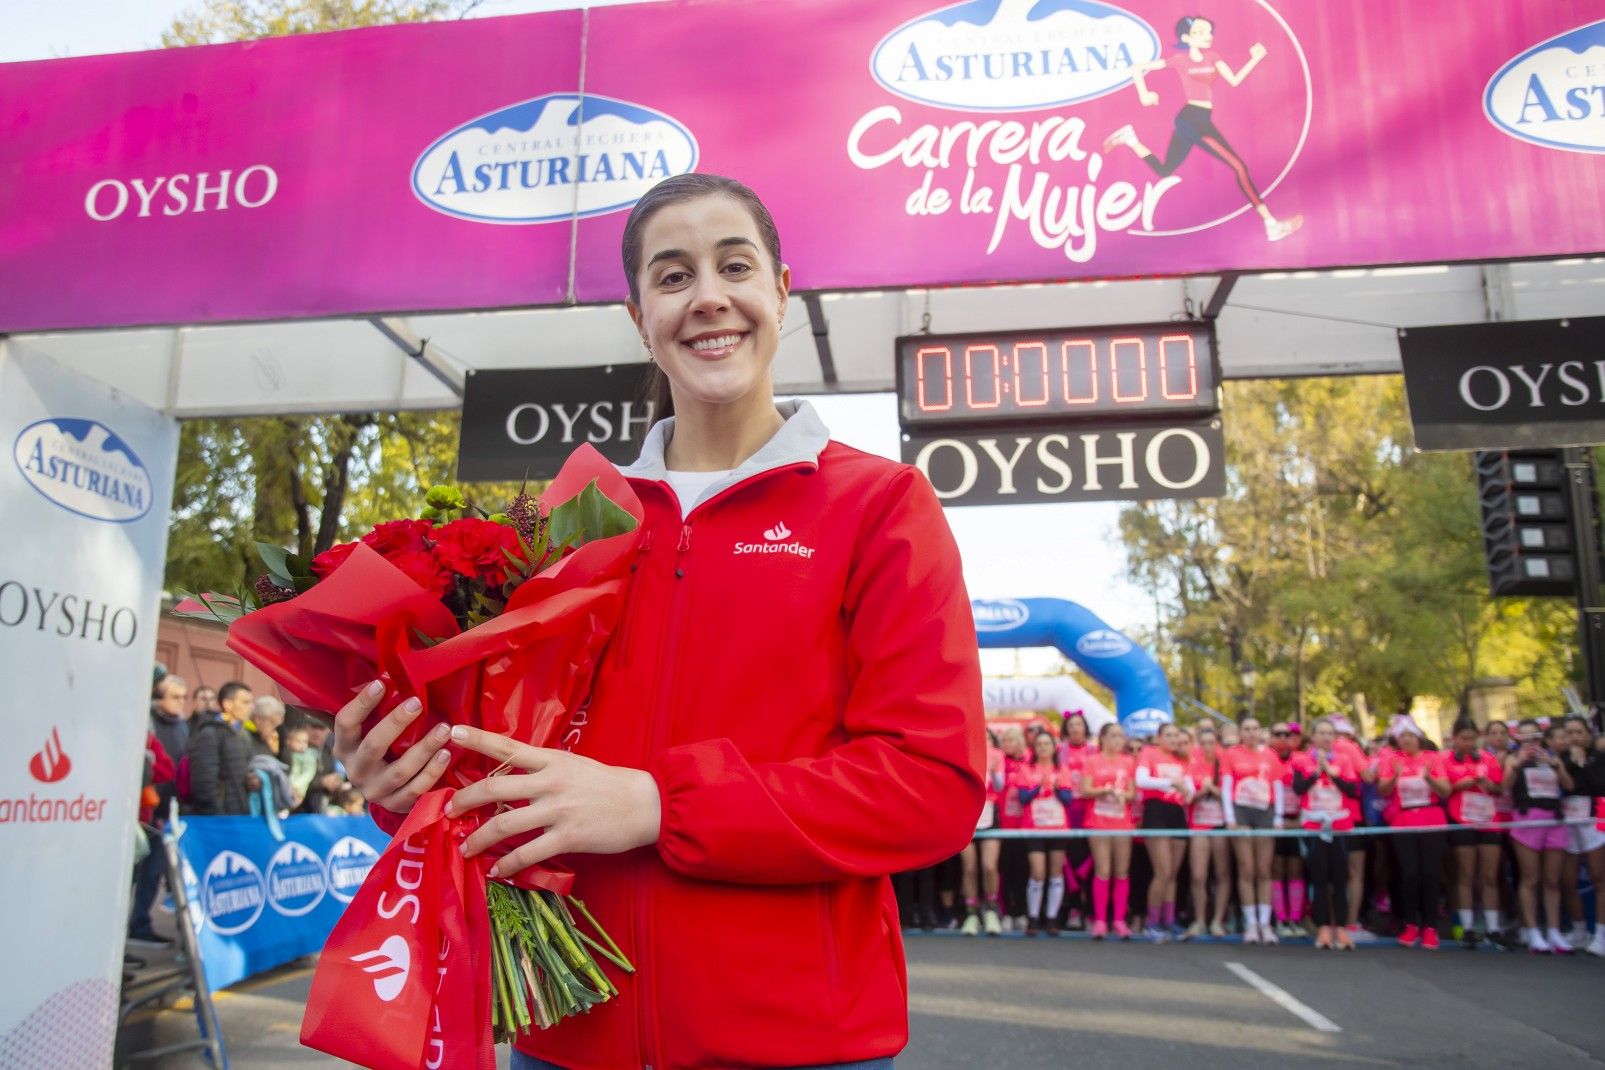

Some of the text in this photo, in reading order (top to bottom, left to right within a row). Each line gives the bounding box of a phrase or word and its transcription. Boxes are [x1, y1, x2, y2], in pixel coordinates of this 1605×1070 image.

[896, 42, 1136, 82] ASTURIANA
[1566, 64, 1605, 79] CE
[478, 136, 566, 156] CENTRAL
[847, 105, 1087, 170] Carrera
[85, 164, 279, 221] OYSHO
[433, 149, 673, 195] ASTURIANA
[905, 153, 1182, 263] de la Mujer
[25, 437, 144, 511] ASTURIANA
[915, 428, 1211, 499] OYSHO
[733, 541, 816, 559] Santander
[0, 581, 138, 648] OYSHO
